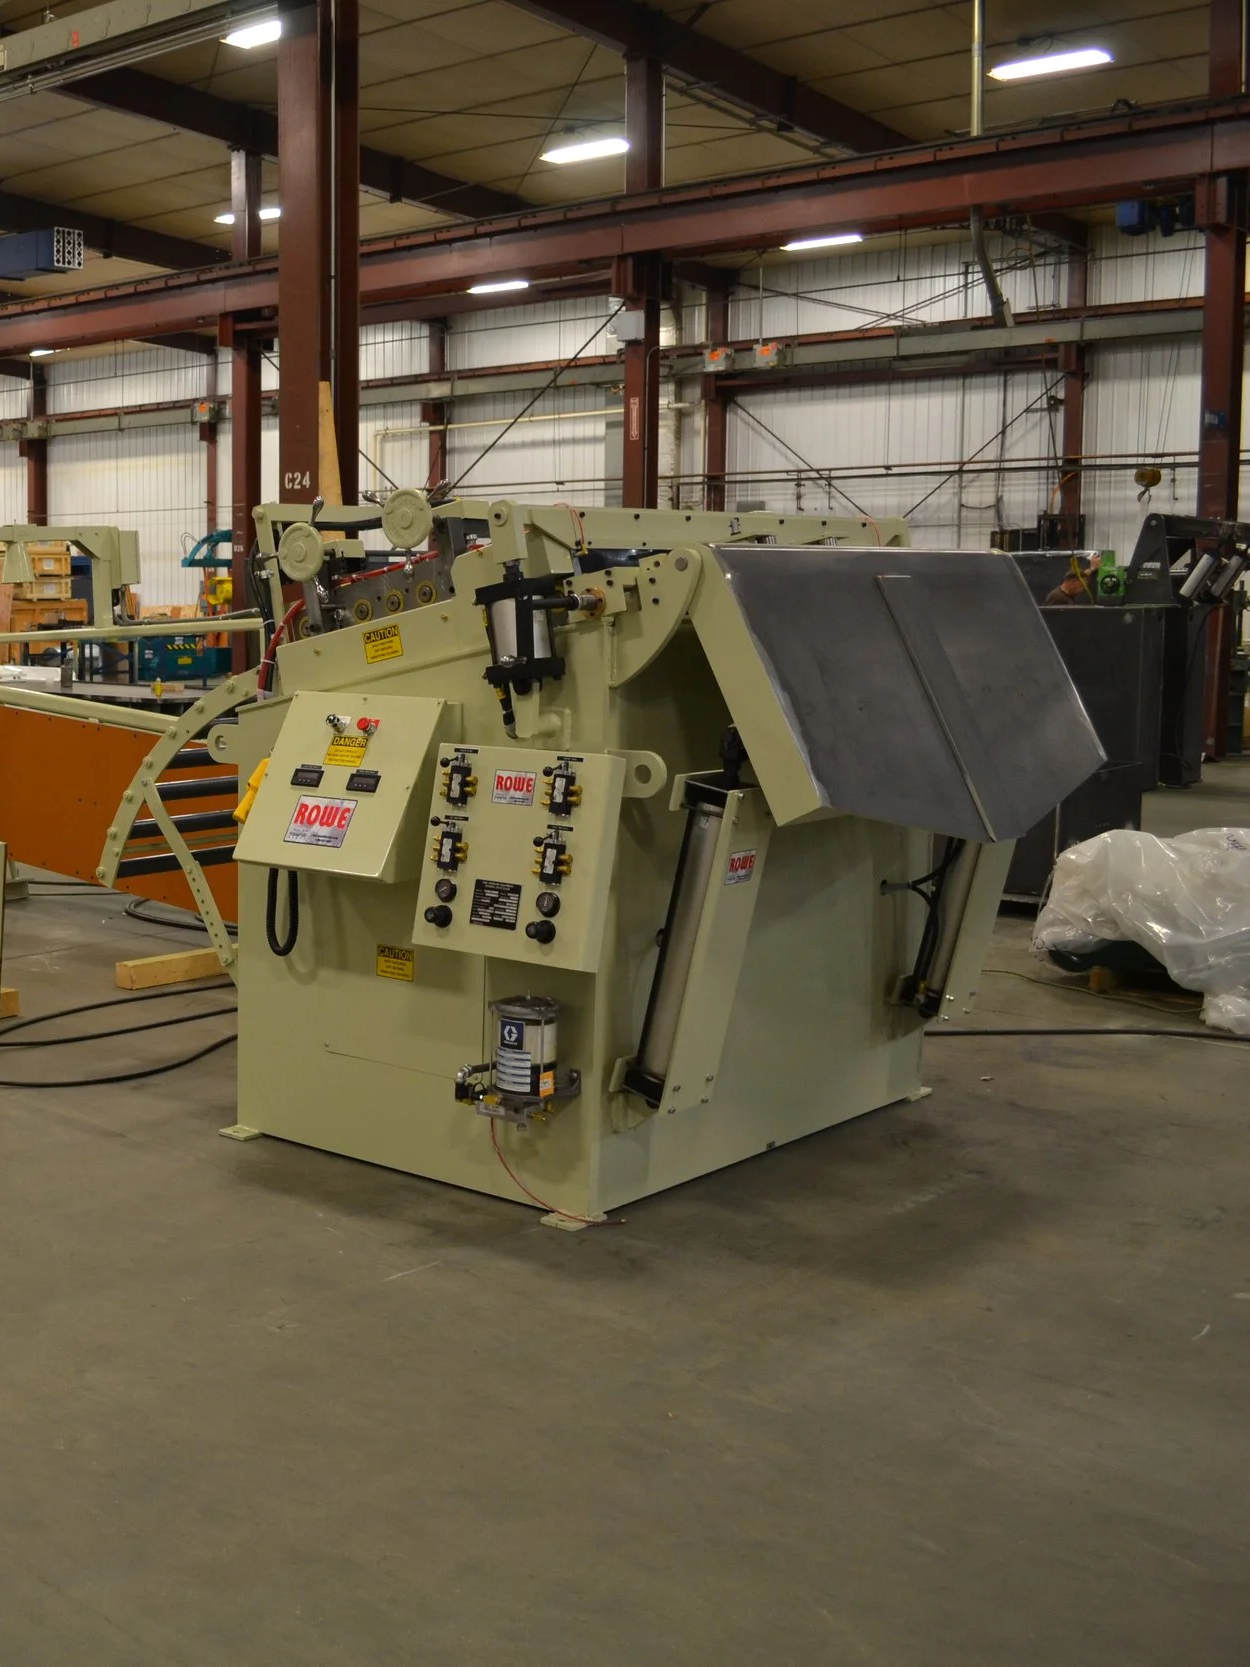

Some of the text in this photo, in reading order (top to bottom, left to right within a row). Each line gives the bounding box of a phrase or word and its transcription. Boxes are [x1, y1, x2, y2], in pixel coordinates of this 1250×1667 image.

[284, 471, 311, 489] C24
[364, 626, 399, 644] CAUTION
[333, 736, 368, 748] DANGER
[495, 775, 534, 793] ROWE
[294, 803, 351, 830] ROWE
[729, 854, 755, 873] ROWE
[379, 946, 413, 961] CAUTION
